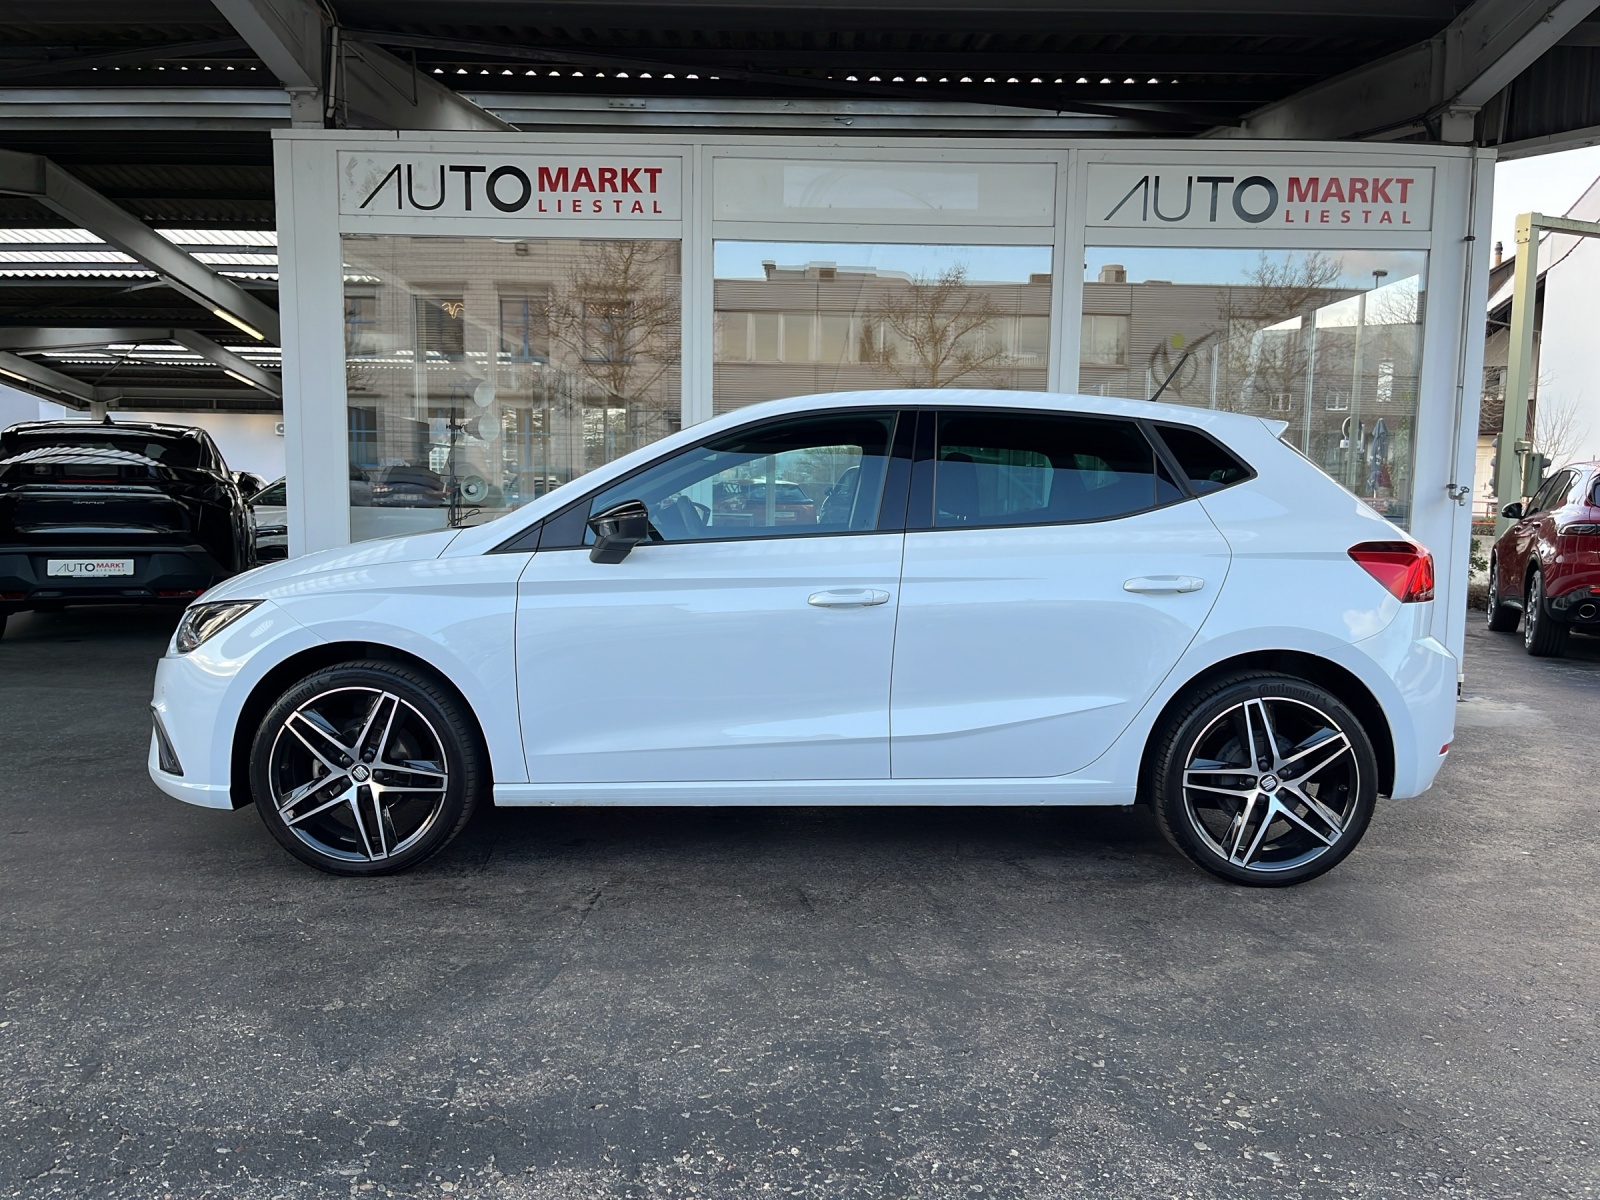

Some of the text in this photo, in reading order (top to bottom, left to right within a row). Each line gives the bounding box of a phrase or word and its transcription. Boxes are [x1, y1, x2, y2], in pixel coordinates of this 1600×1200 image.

[359, 164, 663, 212] AUTO MARKT
[538, 199, 663, 213] LIESTAL
[1104, 175, 1415, 223] AUTO MARKT
[1285, 210, 1411, 224] LIESTAL
[56, 563, 96, 572] AUTO
[1258, 684, 1320, 702] Continental
